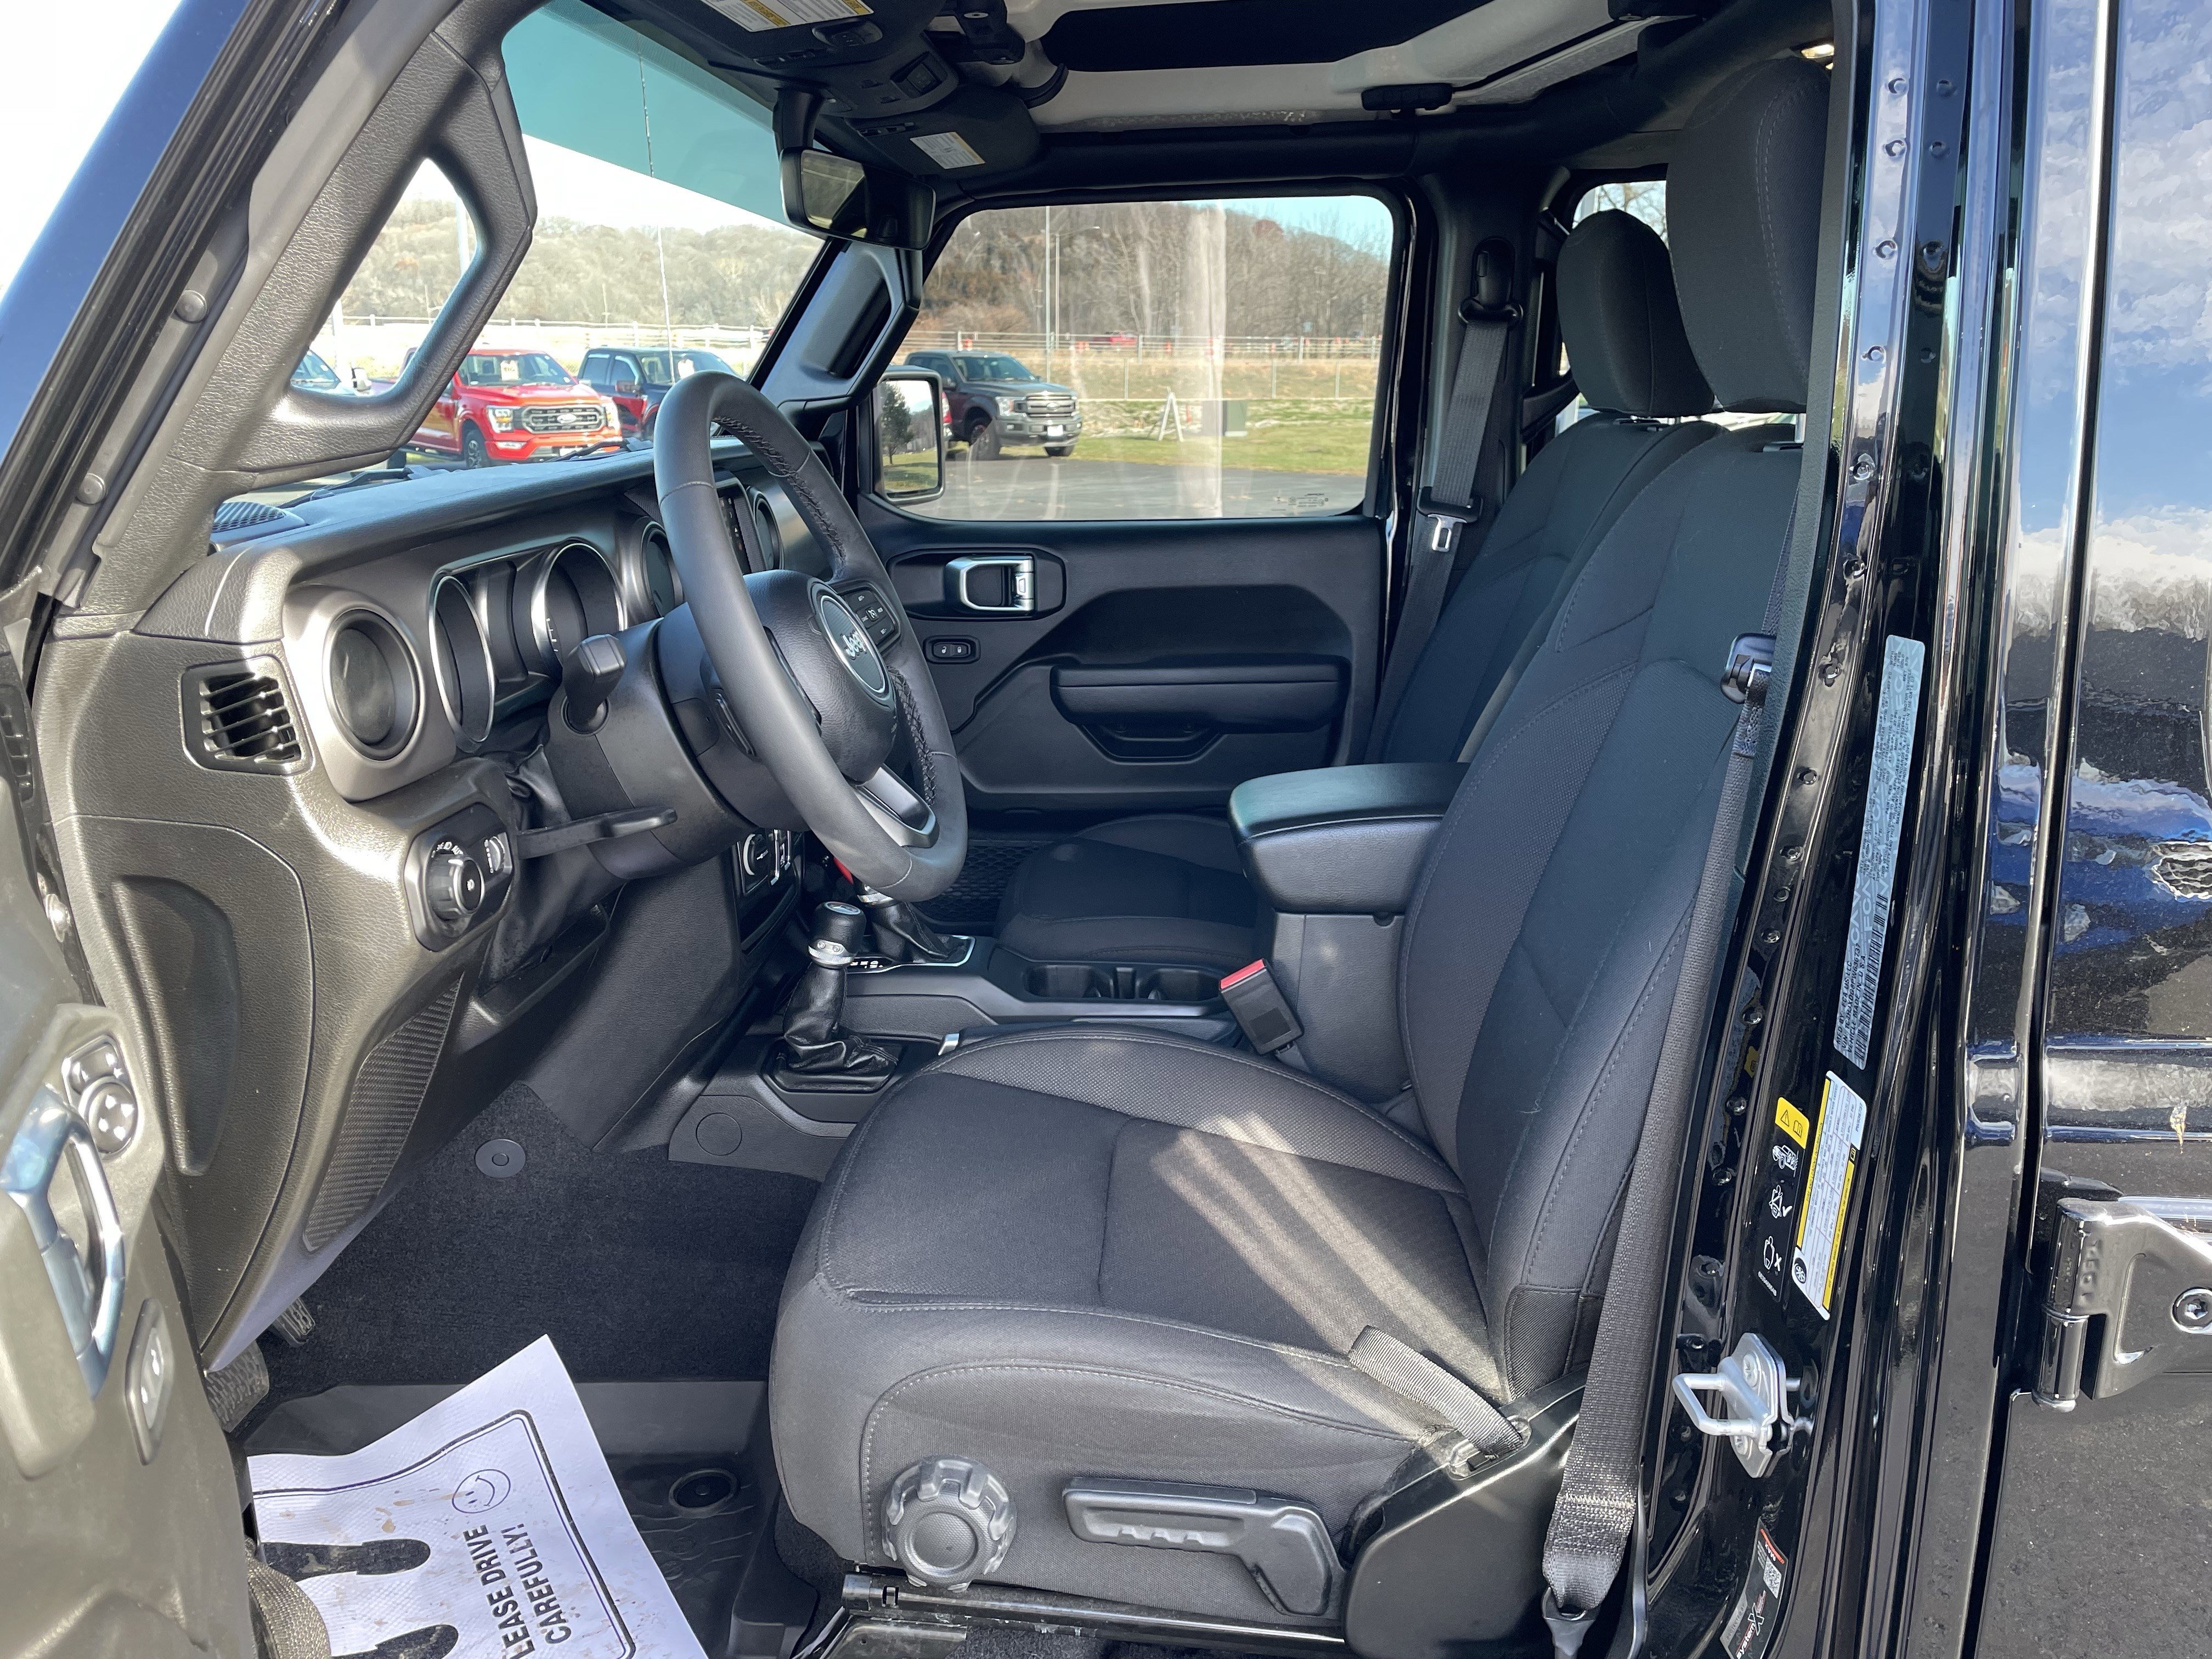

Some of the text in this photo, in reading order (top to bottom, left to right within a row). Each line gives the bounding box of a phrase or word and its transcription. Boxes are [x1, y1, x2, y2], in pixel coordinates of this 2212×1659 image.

[1843, 976, 1849, 990] US
[1847, 1018, 1857, 1055] VEHICLE
[1855, 981, 1861, 993] IN
[464, 1524, 535, 1659] LEASE DRIVE
[500, 1523, 572, 1644] CAREFULLY!
